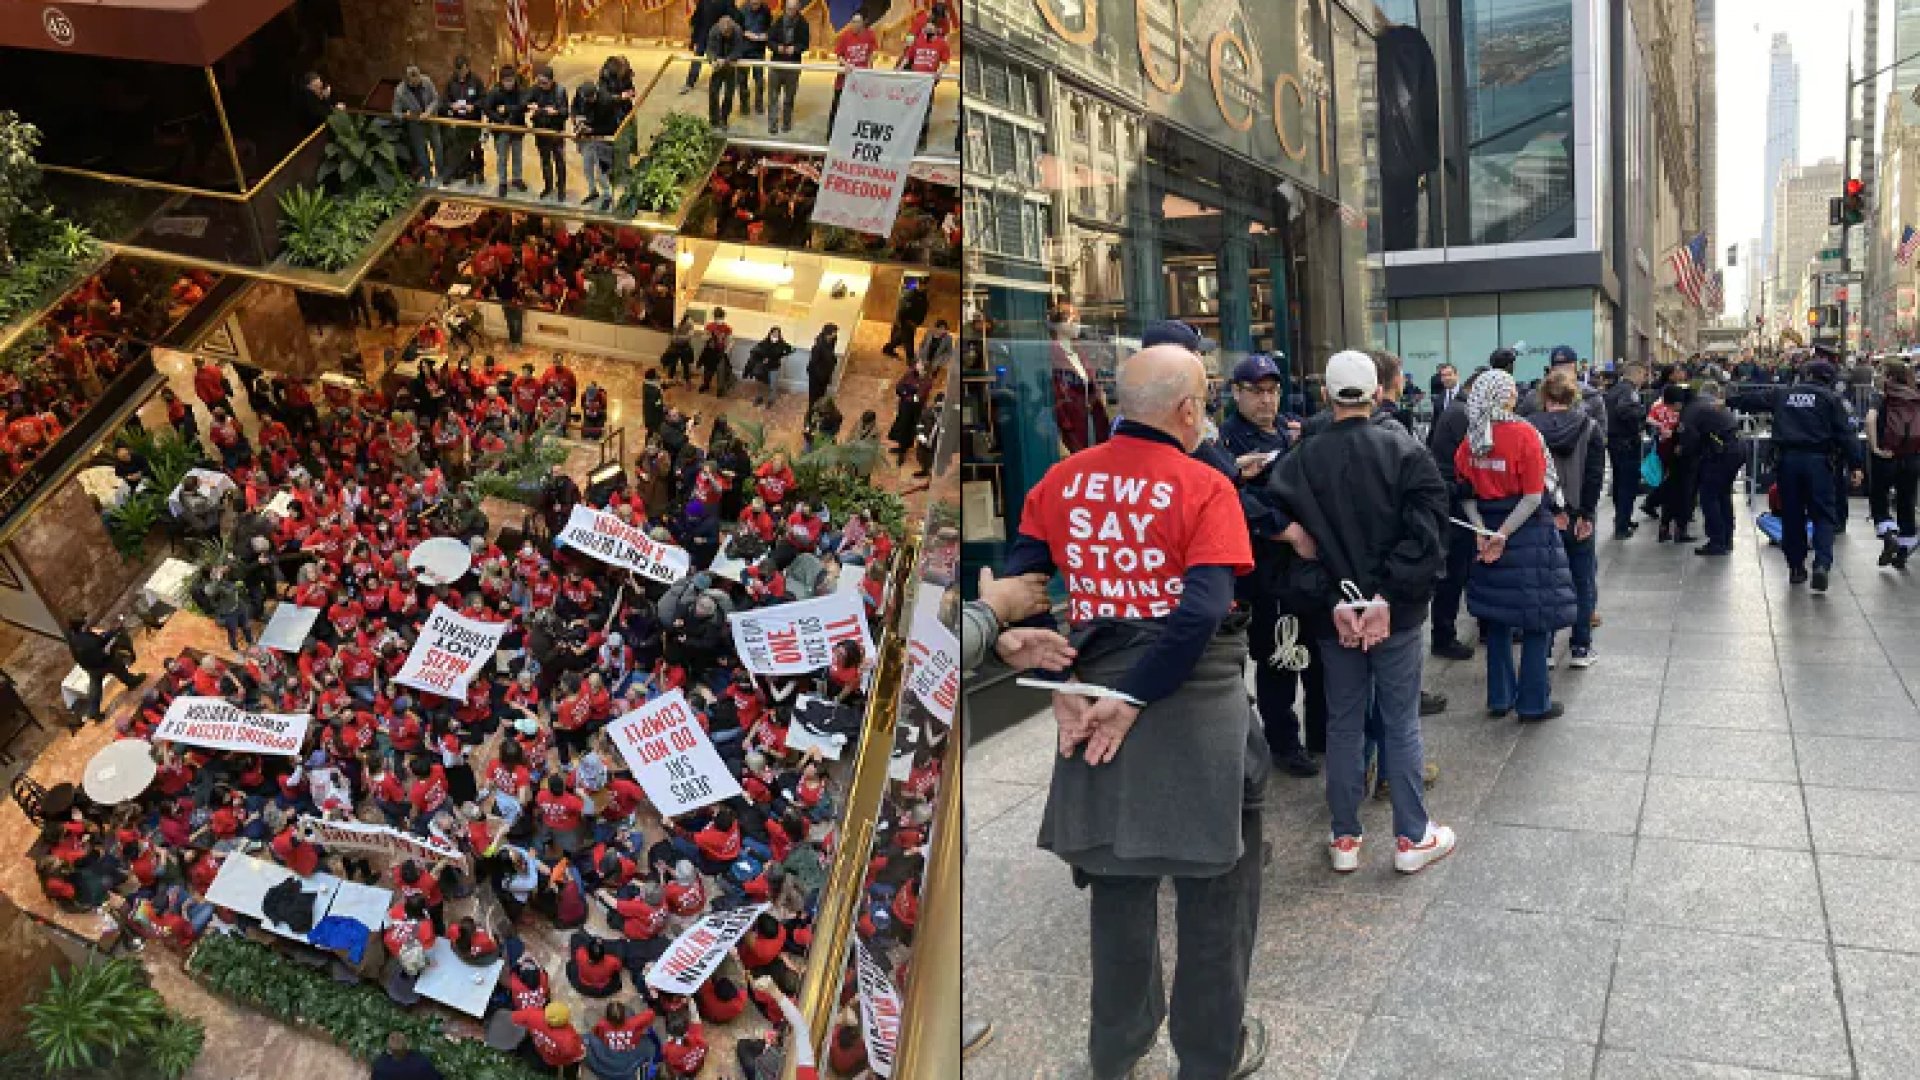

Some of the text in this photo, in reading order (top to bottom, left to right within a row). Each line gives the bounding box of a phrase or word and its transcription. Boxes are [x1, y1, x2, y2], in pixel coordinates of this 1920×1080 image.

[851, 120, 894, 142] JEWS
[852, 142, 883, 162] FOR
[824, 173, 893, 201] FREEDOM
[1062, 472, 1173, 510] JEWS
[1069, 507, 1154, 543] SAY
[1066, 543, 1165, 571] STOP
[1069, 573, 1184, 598] ARMING
[1071, 598, 1180, 620] ISRAE
[799, 616, 821, 635] US
[431, 636, 479, 658] NOT
[767, 620, 803, 664] ONE.
[422, 649, 471, 674] NAZIS
[623, 702, 688, 746] COMPLY
[637, 726, 698, 766] DO NOT
[665, 755, 696, 781] SAY
[670, 774, 713, 804] JEWS
